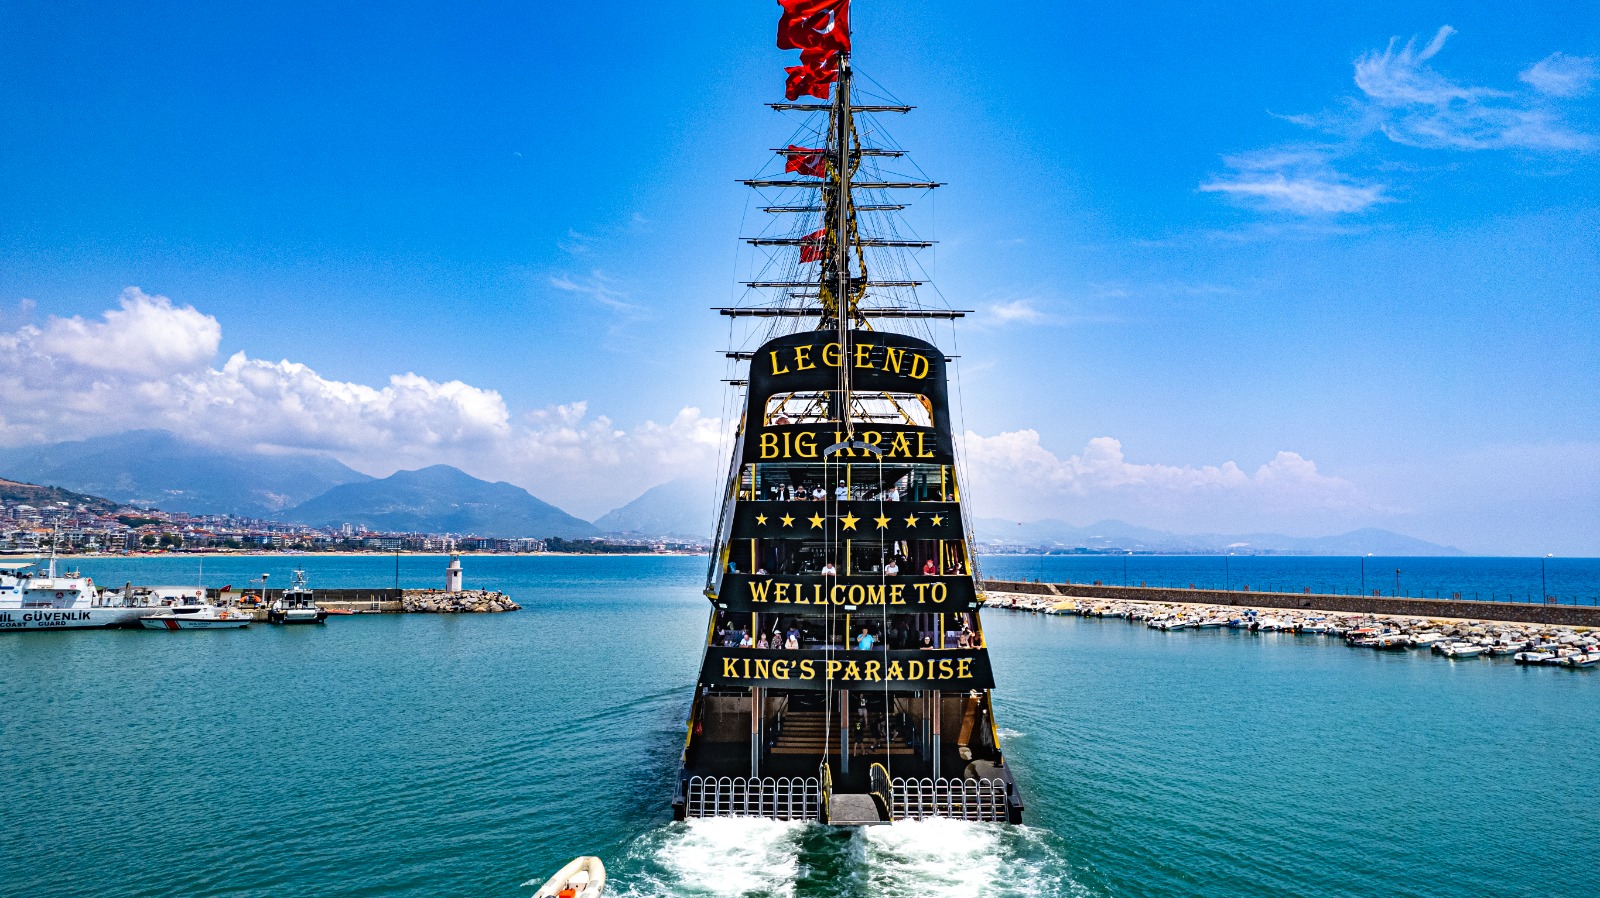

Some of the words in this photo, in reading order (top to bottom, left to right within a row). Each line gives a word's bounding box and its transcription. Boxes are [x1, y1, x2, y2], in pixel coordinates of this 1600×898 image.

[770, 343, 929, 379] LEGEND
[759, 432, 818, 459] BIG
[833, 431, 935, 459] KRAL
[749, 579, 906, 605] WELLCOME
[914, 582, 948, 604] TO
[22, 606, 92, 622] GÜVENLİK
[722, 656, 816, 681] KING'S
[826, 658, 974, 683] PARADISE
